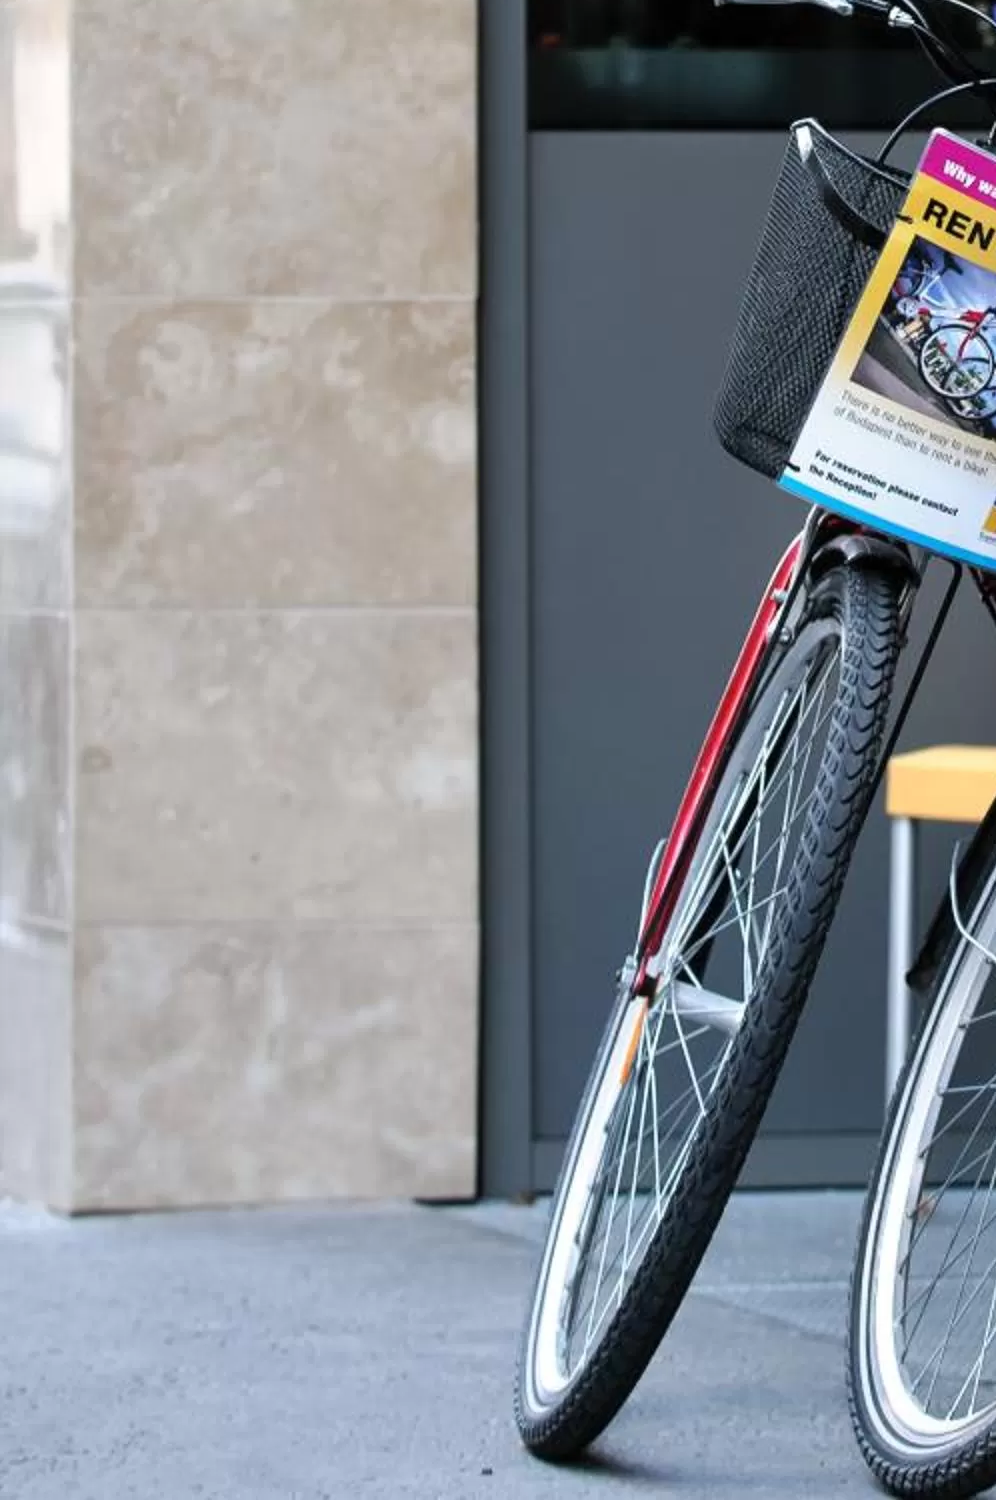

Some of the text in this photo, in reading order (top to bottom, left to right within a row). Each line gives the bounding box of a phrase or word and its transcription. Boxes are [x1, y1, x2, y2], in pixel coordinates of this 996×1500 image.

[943, 159, 975, 189] Why
[809, 464, 878, 501] the Reception!
[815, 450, 832, 463] For
[887, 483, 920, 502] please
[921, 496, 959, 517] contact
